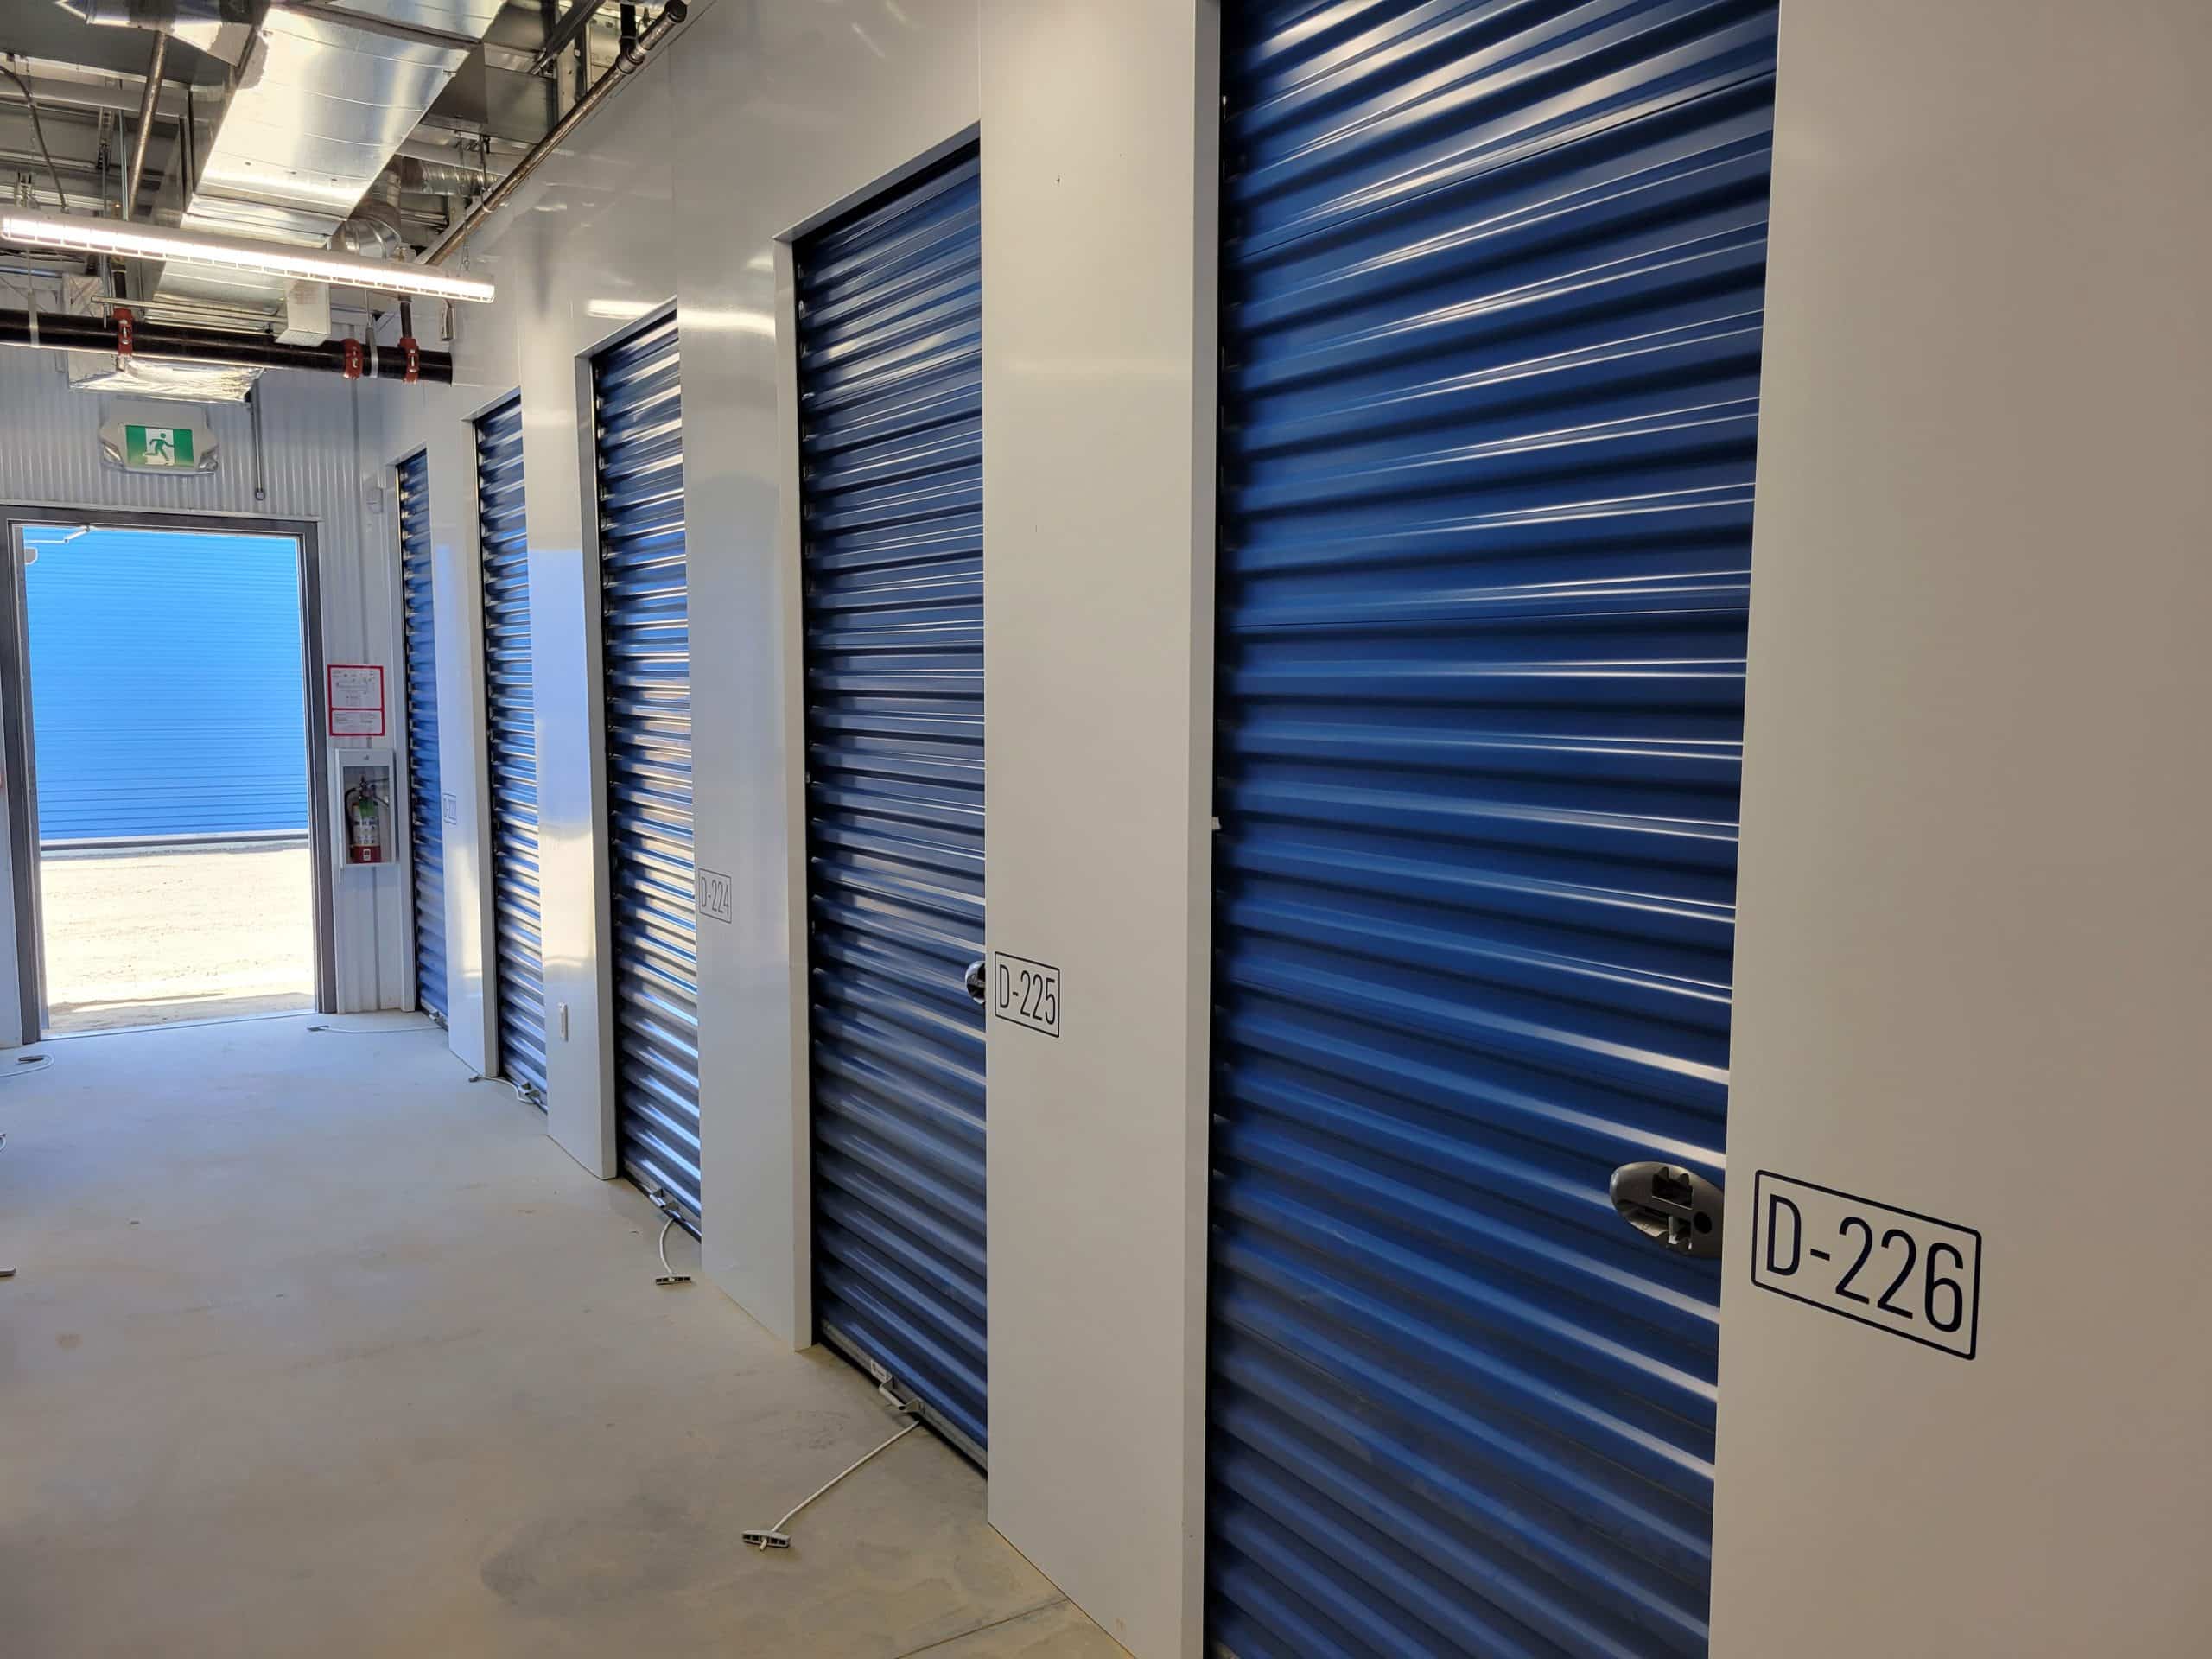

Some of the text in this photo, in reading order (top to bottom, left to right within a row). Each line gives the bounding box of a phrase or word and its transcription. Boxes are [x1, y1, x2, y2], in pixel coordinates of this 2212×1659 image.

[701, 876, 729, 916] D-224
[1000, 964, 1056, 1025] D-225
[1767, 1193, 1964, 1332] D-226
